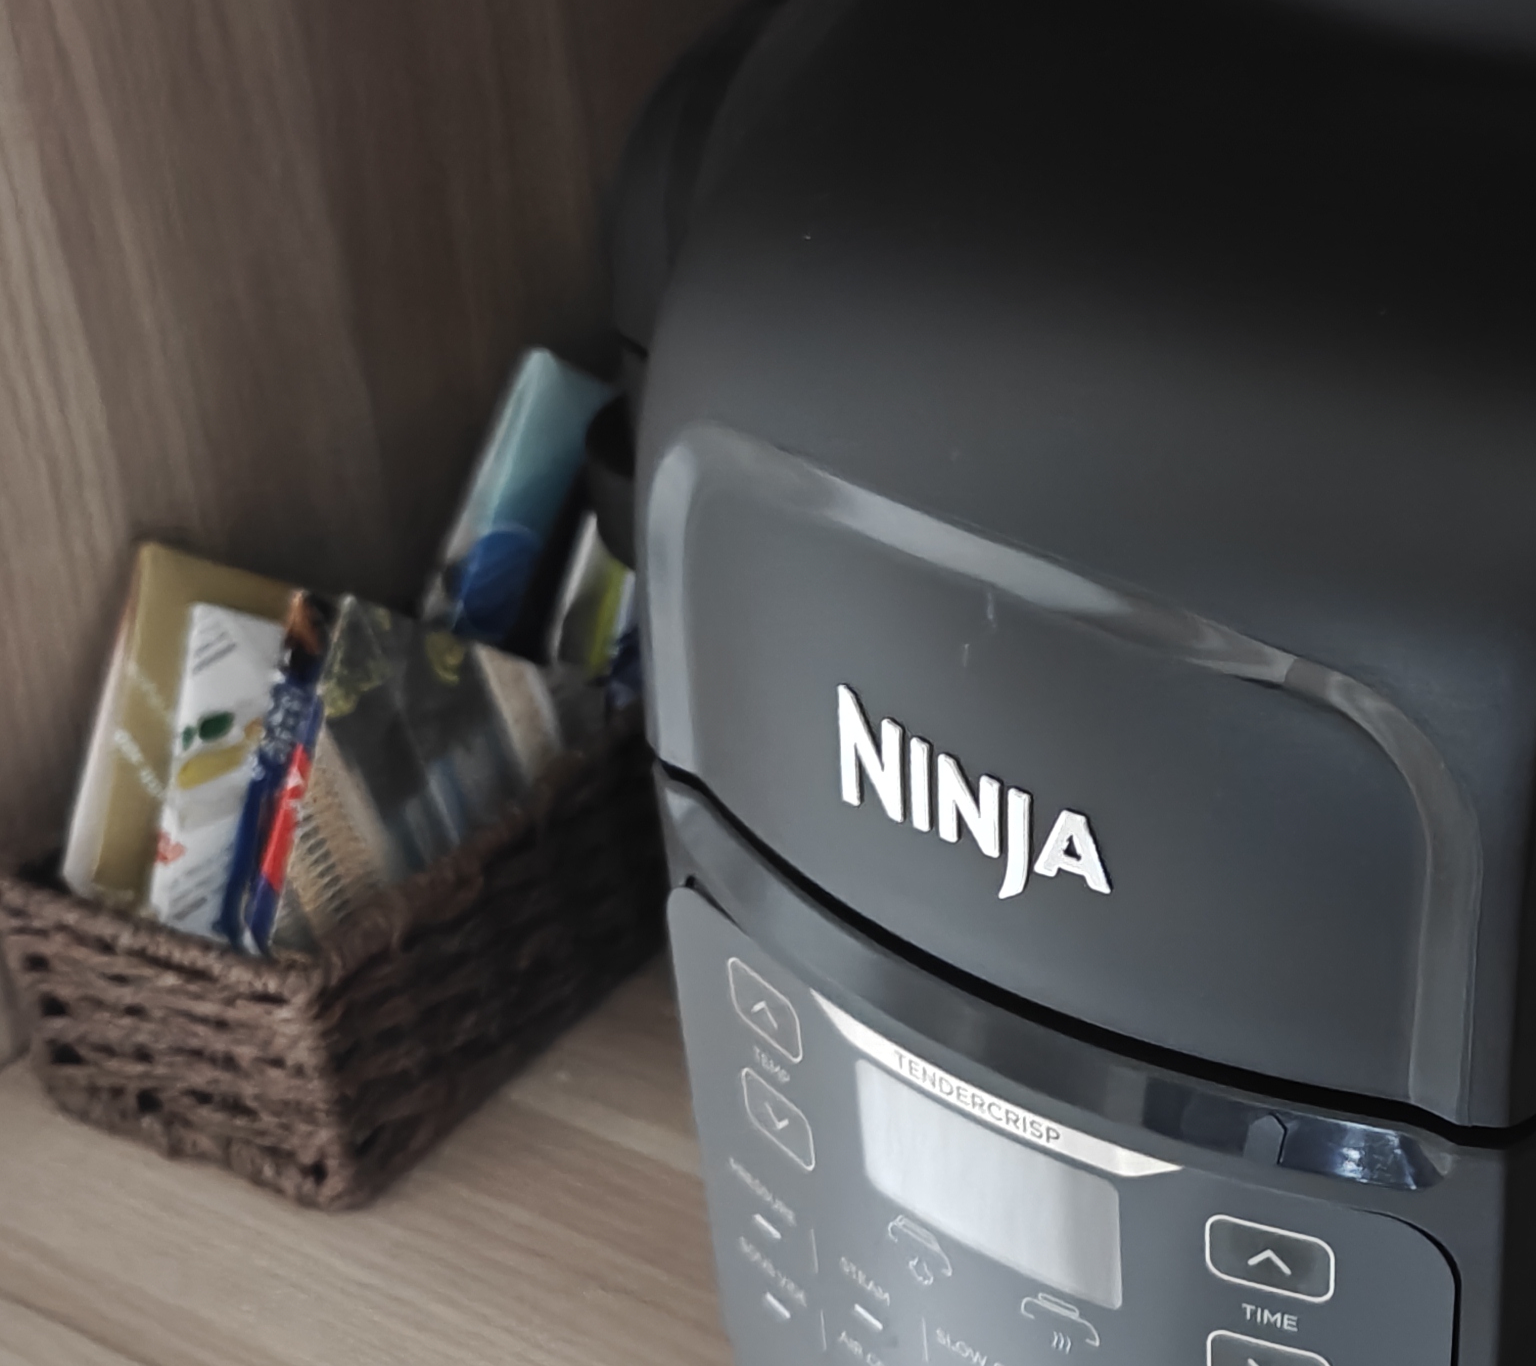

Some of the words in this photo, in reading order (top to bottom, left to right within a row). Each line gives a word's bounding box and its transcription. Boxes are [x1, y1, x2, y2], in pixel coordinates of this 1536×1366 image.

[837, 683, 1112, 899] NINJA
[893, 1049, 1061, 1144] TENDERCRISP
[1242, 1302, 1299, 1332] TIME
